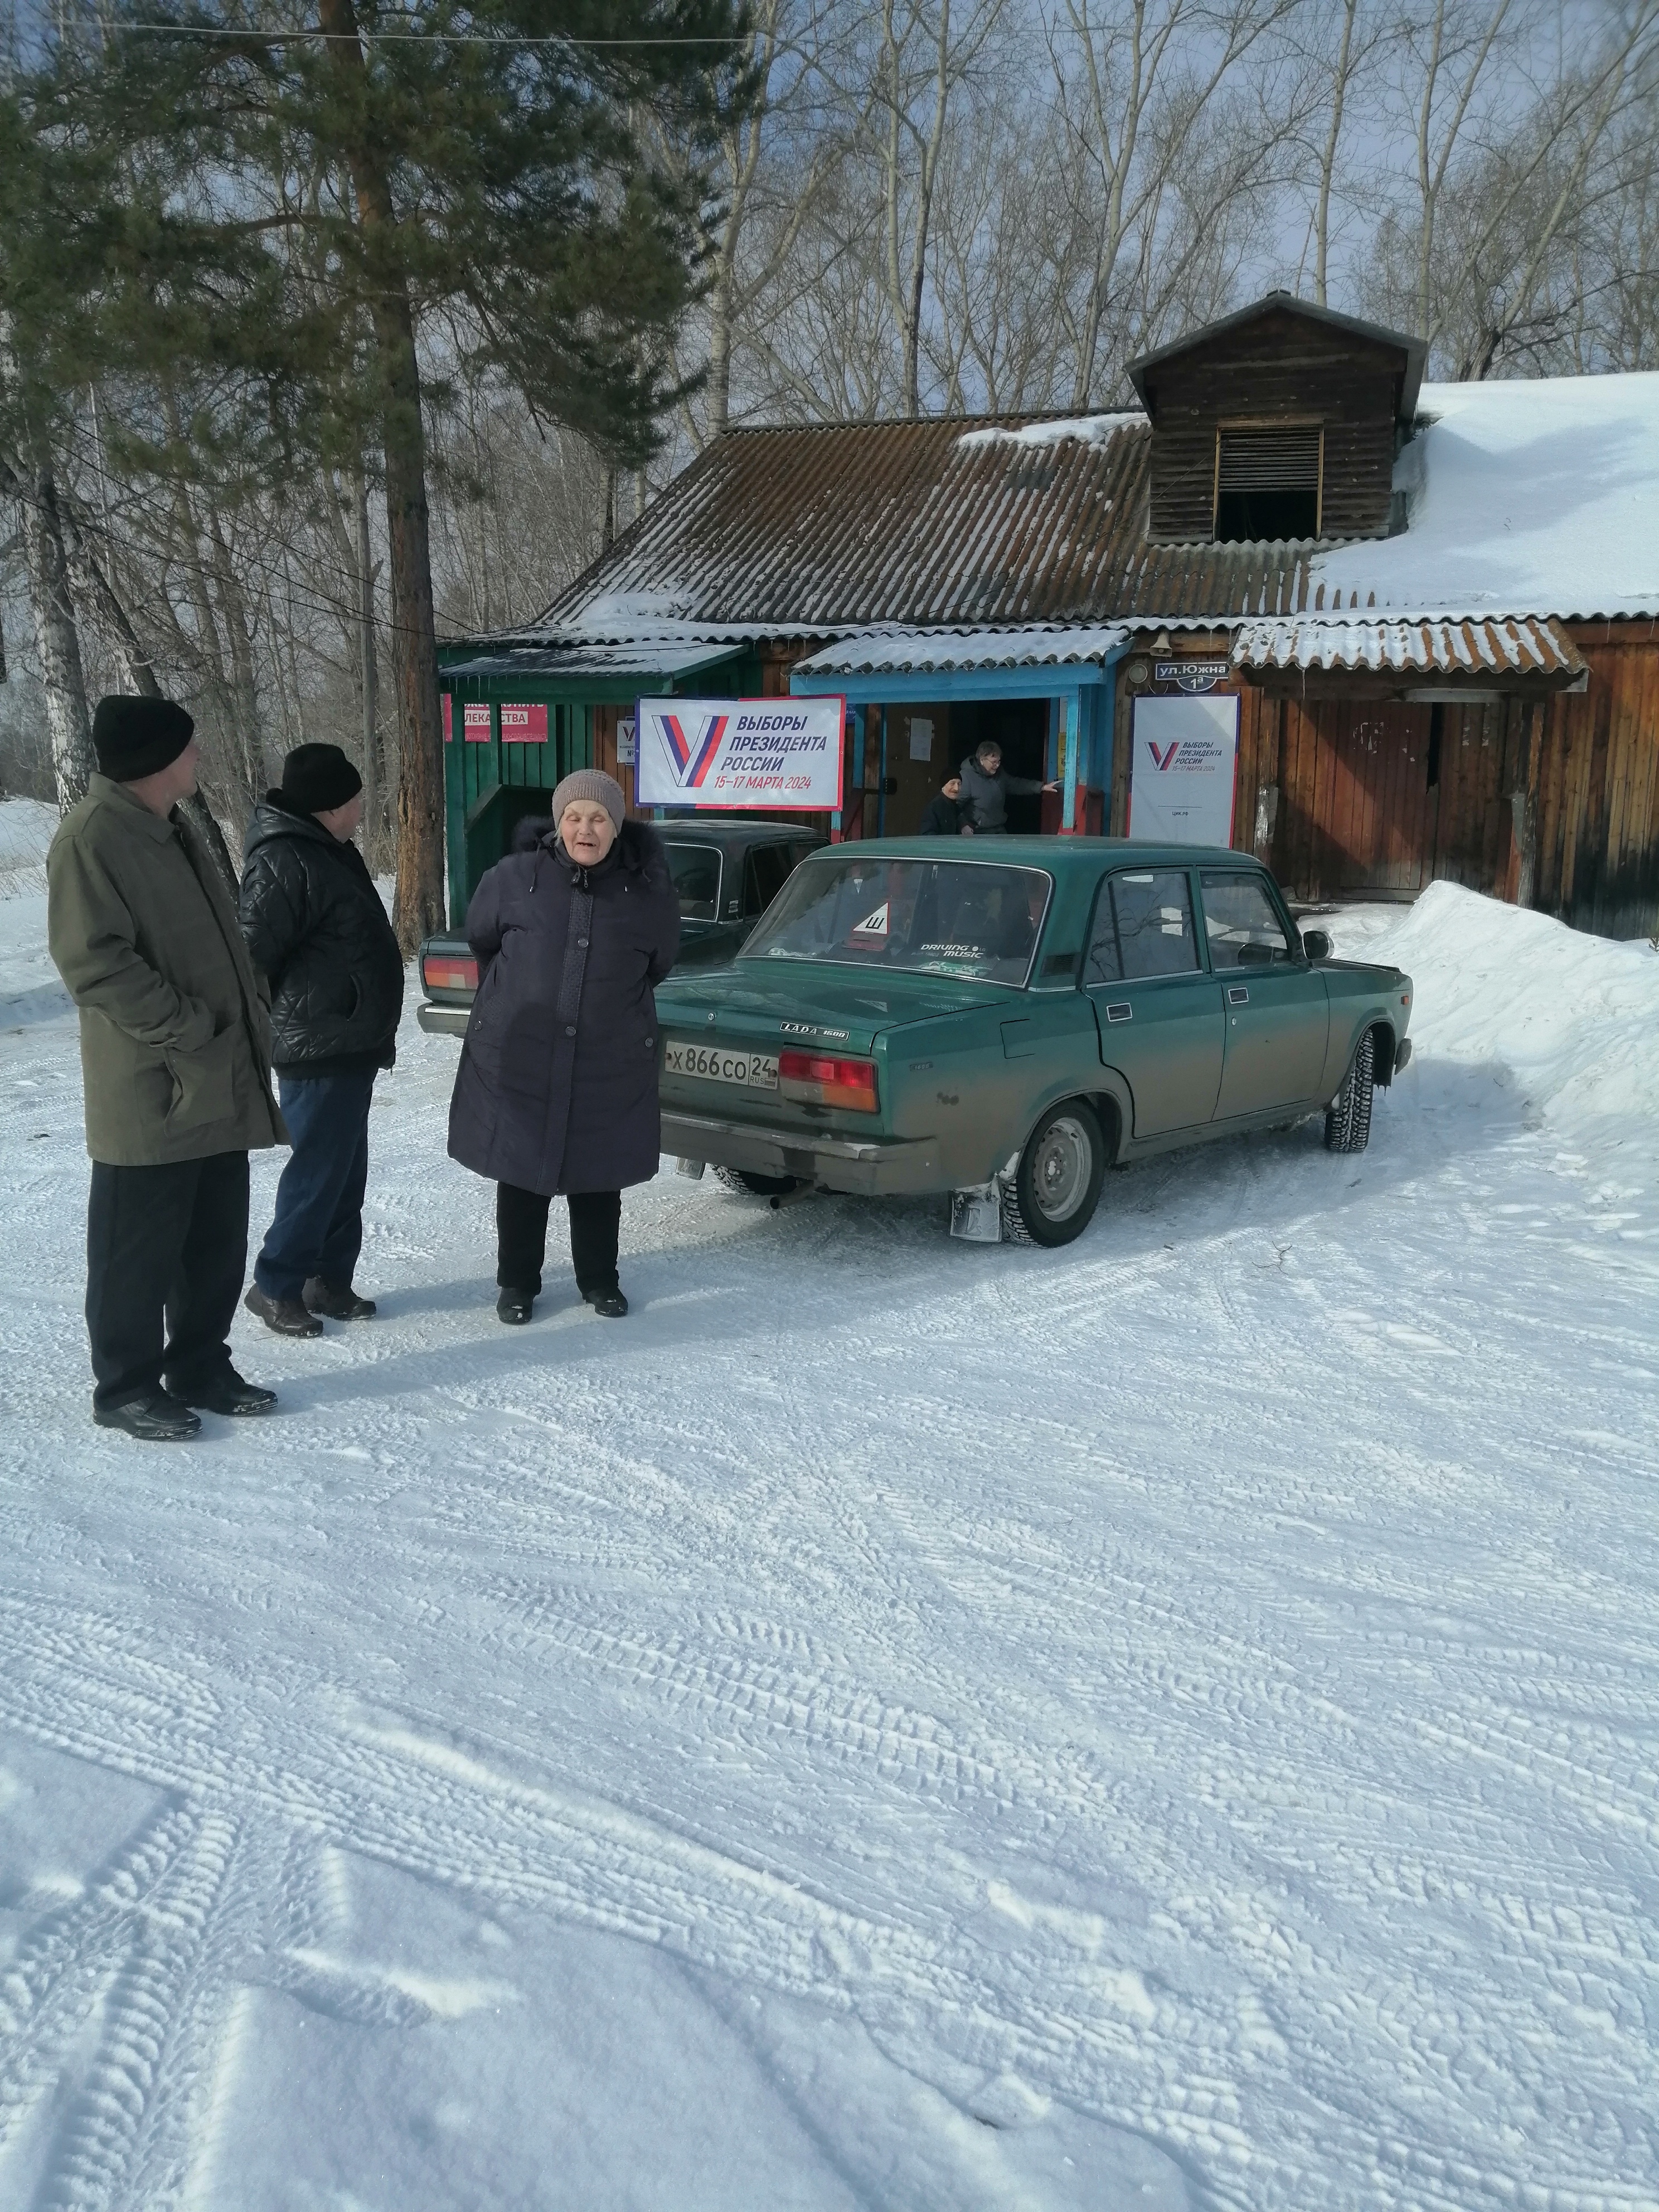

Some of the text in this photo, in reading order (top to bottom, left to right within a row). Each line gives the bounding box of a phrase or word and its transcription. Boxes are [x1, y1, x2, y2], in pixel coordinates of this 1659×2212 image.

[1160, 664, 1228, 676] ул.Южна
[736, 716, 808, 731] ВЫБОРЫ
[729, 736, 827, 754] ПРЕЗИДЕНТА
[720, 756, 785, 772] РОССИИ
[745, 776, 783, 789] МАРТА
[784, 777, 812, 789] 2024
[865, 917, 885, 929] Ш
[784, 1023, 846, 1039] LADA 1600
[751, 1057, 772, 1076] 24
[750, 1076, 764, 1084] RUS
